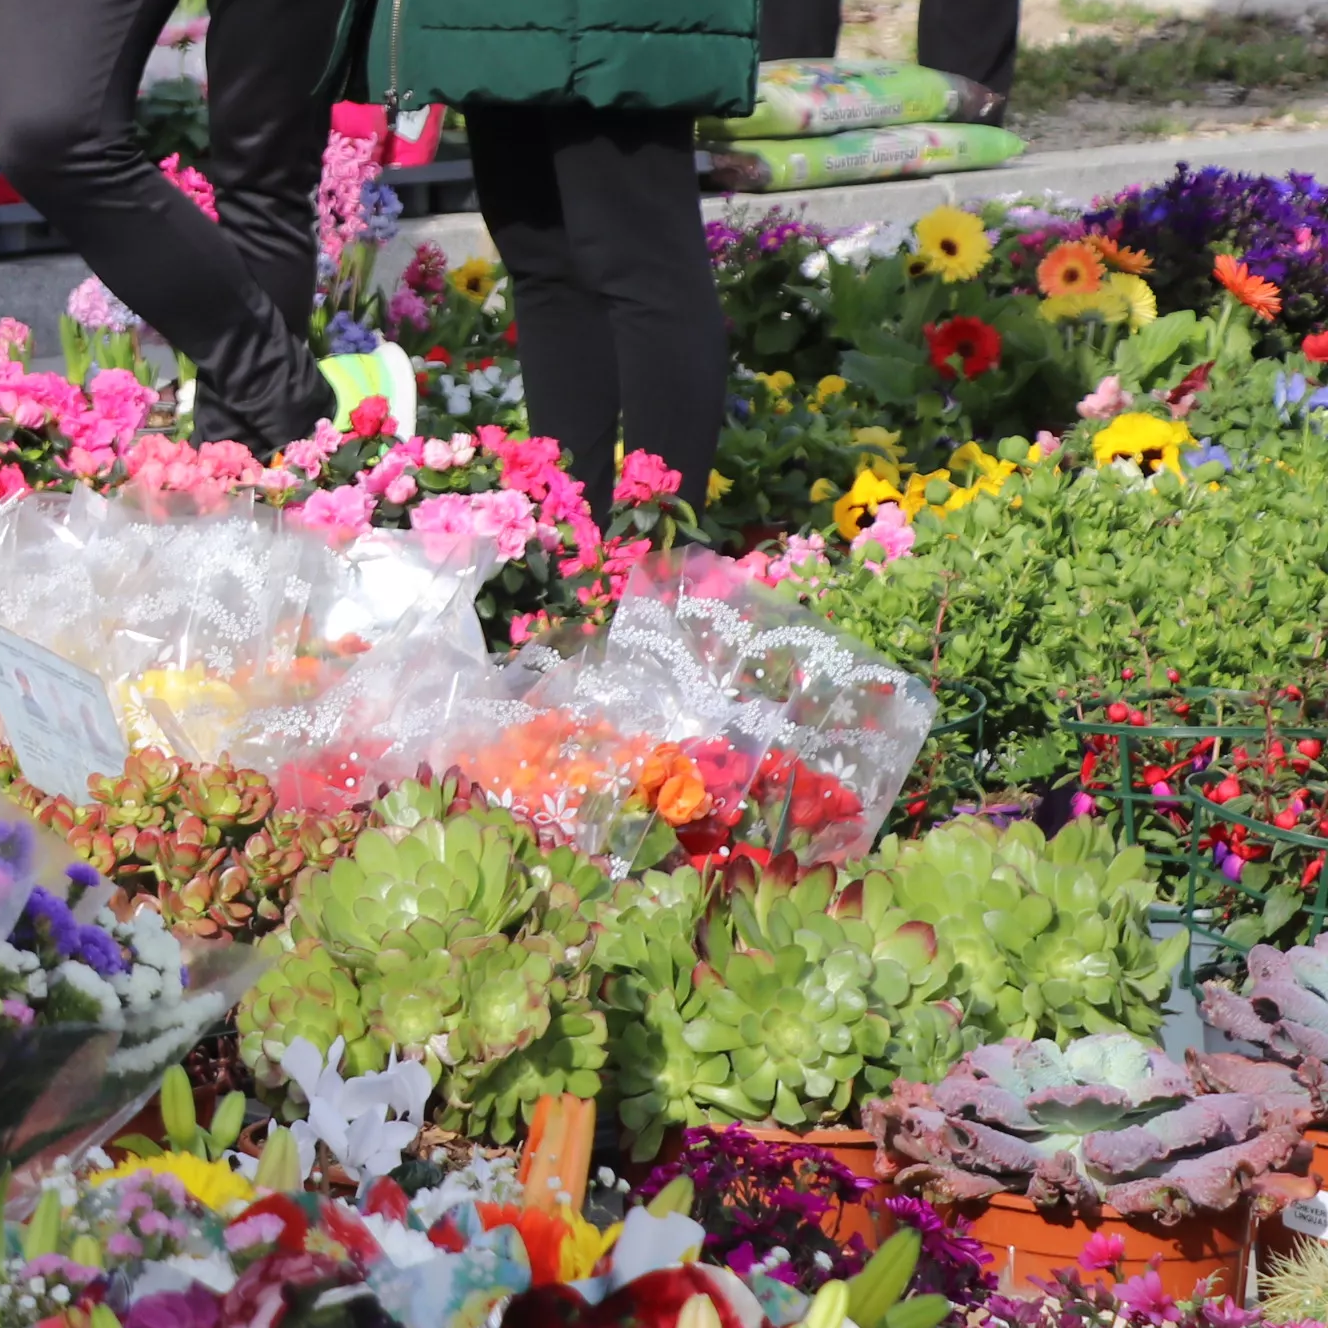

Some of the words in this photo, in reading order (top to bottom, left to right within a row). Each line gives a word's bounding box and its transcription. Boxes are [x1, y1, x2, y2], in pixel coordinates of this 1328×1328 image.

[822, 104, 862, 121] Sustrato
[864, 102, 903, 118] Universal
[825, 153, 869, 169] Sustrato
[872, 145, 918, 164] Universal
